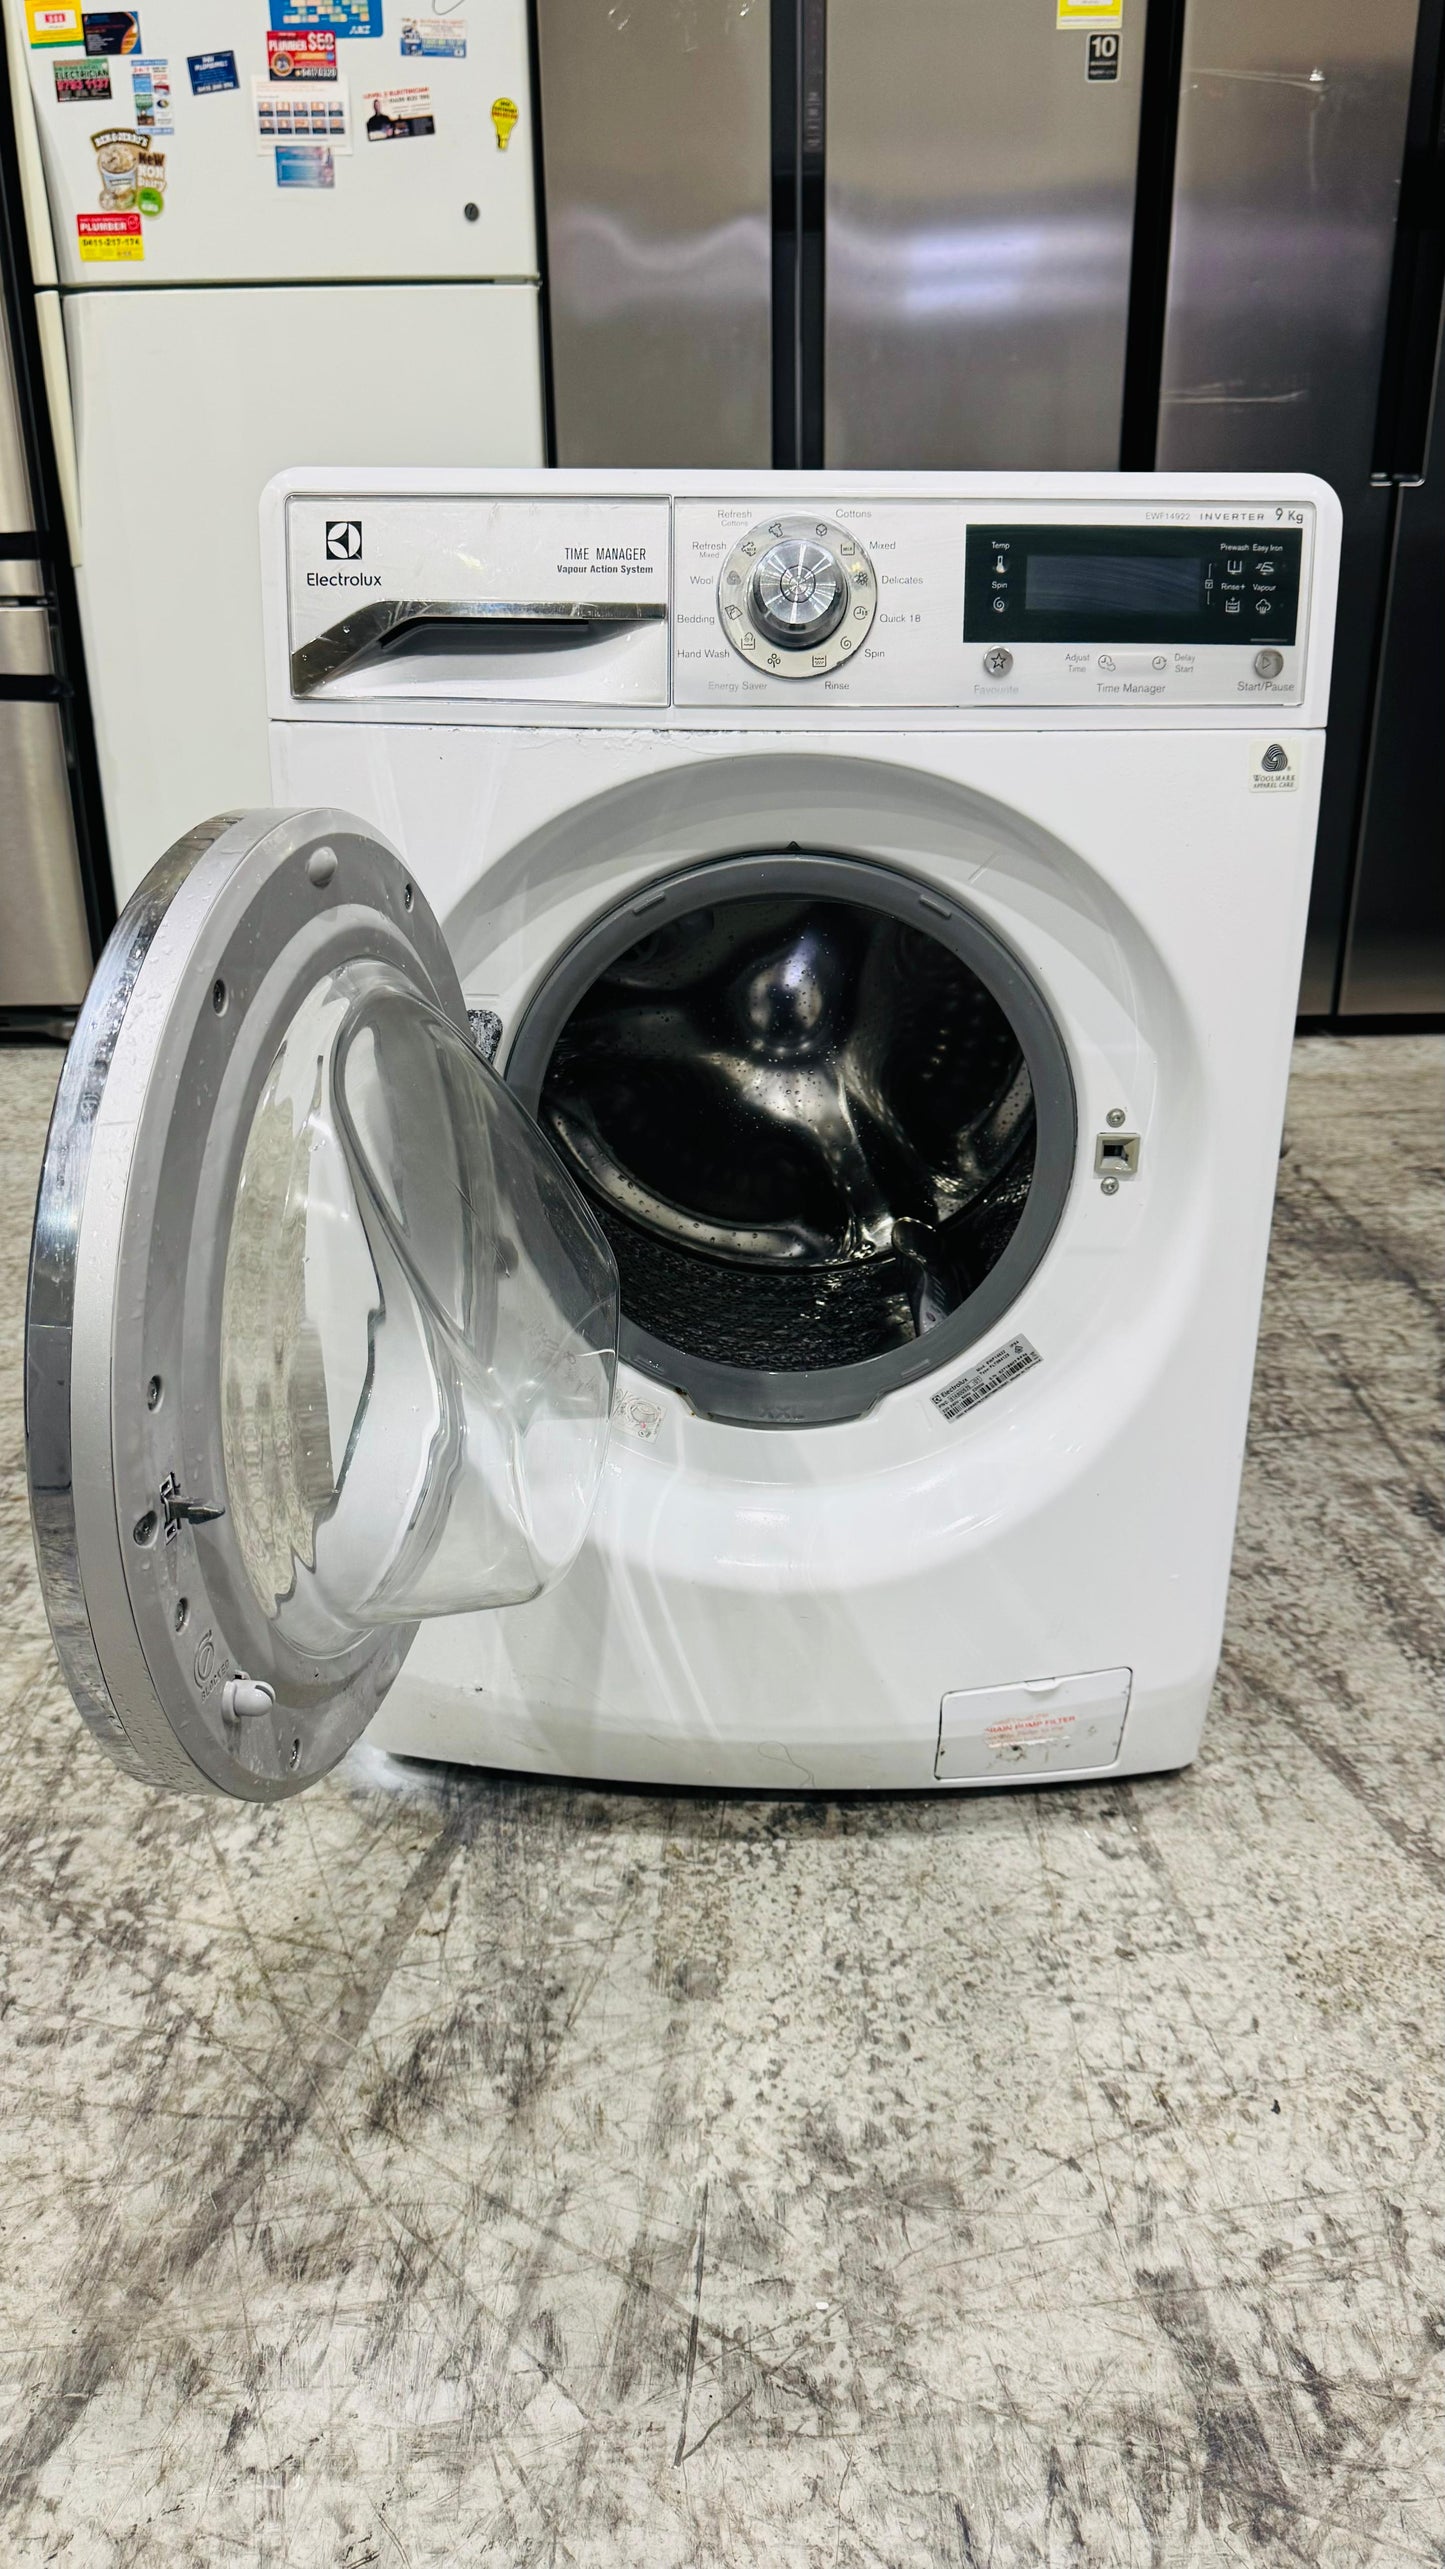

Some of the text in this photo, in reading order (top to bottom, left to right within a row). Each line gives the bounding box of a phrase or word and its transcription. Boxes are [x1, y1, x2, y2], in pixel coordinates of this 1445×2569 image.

[1091, 36, 1117, 58] 10
[80, 221, 127, 232] PLUMBER
[717, 509, 752, 518] Refresh
[836, 509, 872, 518] Cottons
[1200, 512, 1265, 521] INVERTER
[1275, 508, 1284, 521] 9
[1287, 511, 1304, 524] Kg
[692, 541, 727, 550] Refresh
[869, 541, 896, 550] Mixed
[991, 541, 1011, 551] Temp
[1220, 543, 1250, 551] Prewash
[1252, 544, 1269, 554] Easy
[565, 547, 646, 560] TIME MANAGER
[556, 565, 653, 576] Vapour Action System
[306, 572, 382, 587] Electrolux
[689, 576, 714, 585] Wool
[881, 575, 924, 585] Delicates
[991, 580, 1008, 590] Spin
[1252, 584, 1276, 592] Vapour
[677, 614, 715, 625] Bedding
[879, 614, 921, 623] Quick 18
[677, 649, 730, 658] Hand Wash
[864, 648, 885, 659] Spin
[1065, 653, 1090, 664] Adjust
[1174, 653, 1196, 664] Delay
[1068, 664, 1087, 673] Time
[1174, 664, 1194, 673] Start
[708, 681, 768, 693] Energy Saver
[824, 681, 850, 690] Rinse
[1096, 683, 1166, 696] Time Manager
[1237, 680, 1295, 693] Start/Pause
[1252, 774, 1296, 782] WOOLMARK
[941, 1378, 968, 1397] Electrolux
[201, 1658, 230, 1702] BLOCKED
[1014, 1721, 1043, 1729] PUMP
[1045, 1716, 1075, 1726] FILTER
